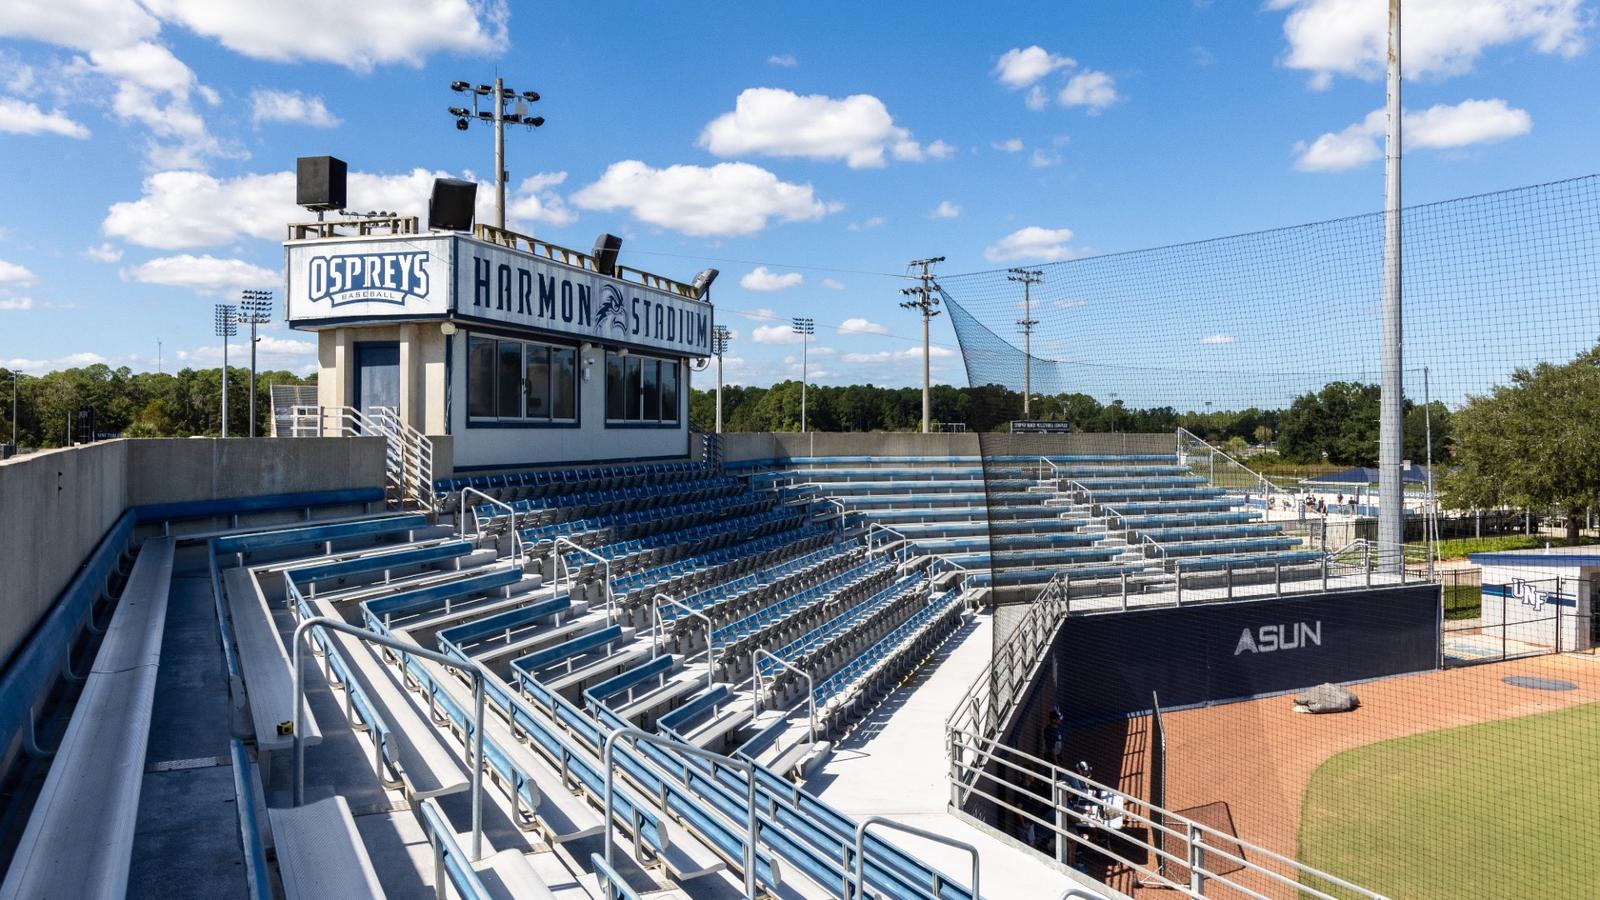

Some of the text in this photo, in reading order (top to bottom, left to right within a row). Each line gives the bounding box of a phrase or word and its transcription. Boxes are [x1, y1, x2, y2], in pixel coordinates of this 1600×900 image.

[310, 253, 429, 300] OSPREYS
[341, 290, 396, 301] BASEBALL
[473, 256, 707, 348] HARMON STADIUM
[1512, 577, 1547, 611] UNF
[1234, 620, 1321, 656] ASUN
